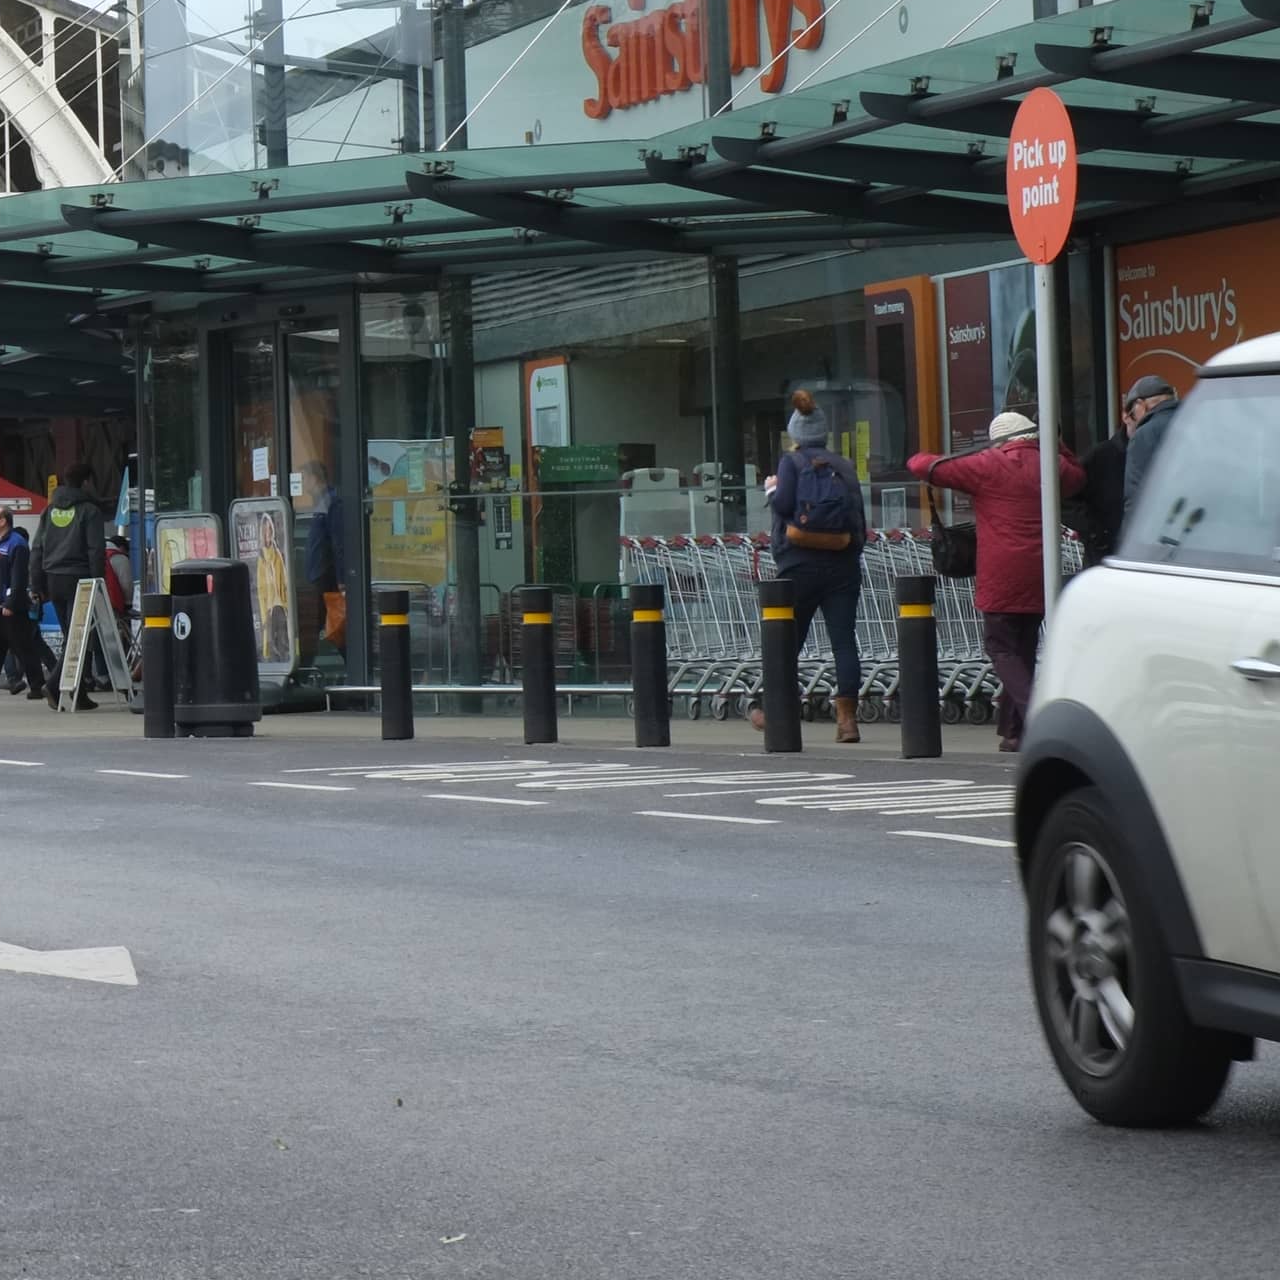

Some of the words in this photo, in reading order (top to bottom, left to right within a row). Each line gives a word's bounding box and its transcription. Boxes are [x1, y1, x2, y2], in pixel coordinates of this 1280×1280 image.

[1013, 138, 1044, 171] Pick
[1048, 139, 1067, 170] up
[1022, 174, 1059, 216] point
[1119, 266, 1146, 281] Welcome
[1147, 264, 1156, 278] to
[1120, 277, 1237, 341] Sainsbury's
[949, 321, 985, 344] Sainsbury's
